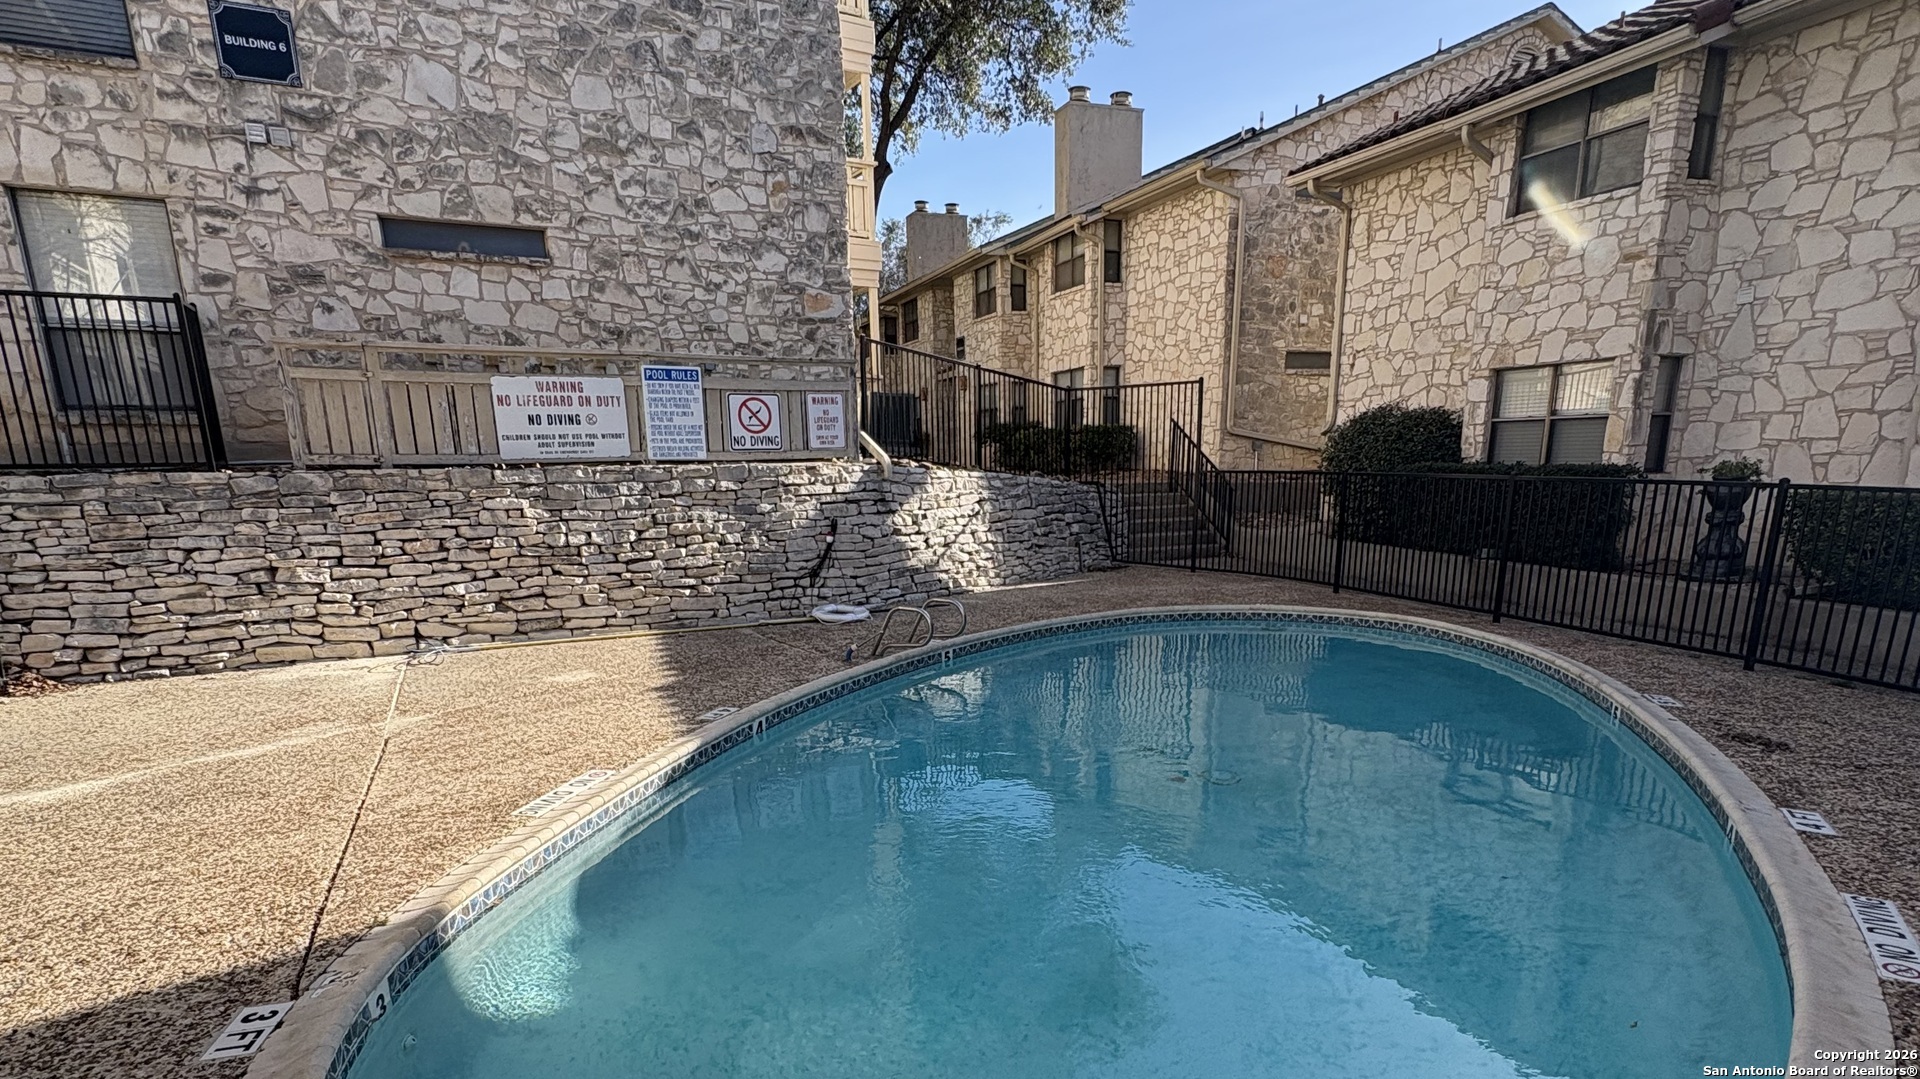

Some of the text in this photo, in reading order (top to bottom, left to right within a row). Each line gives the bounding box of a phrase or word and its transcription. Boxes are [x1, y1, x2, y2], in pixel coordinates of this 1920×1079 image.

[224, 34, 287, 52] BUILDING 6
[646, 369, 698, 381] POOL RULES
[535, 380, 584, 393] WARNING
[496, 394, 621, 407] NO LIFEGUARD ON DUTY
[811, 396, 839, 406] WARNING
[528, 413, 582, 426] NO DIVING
[814, 416, 839, 424] LIFEGUARD
[601, 432, 625, 440] WITHOUT
[733, 435, 780, 447] NO DIVING
[944, 650, 951, 662] 5
[755, 720, 764, 735] 4
[568, 778, 597, 787] NO
[1786, 809, 1822, 822] FT
[1850, 896, 1920, 965] NO DIVING
[374, 993, 388, 1021] 3
[214, 1009, 280, 1053] 3 FT
